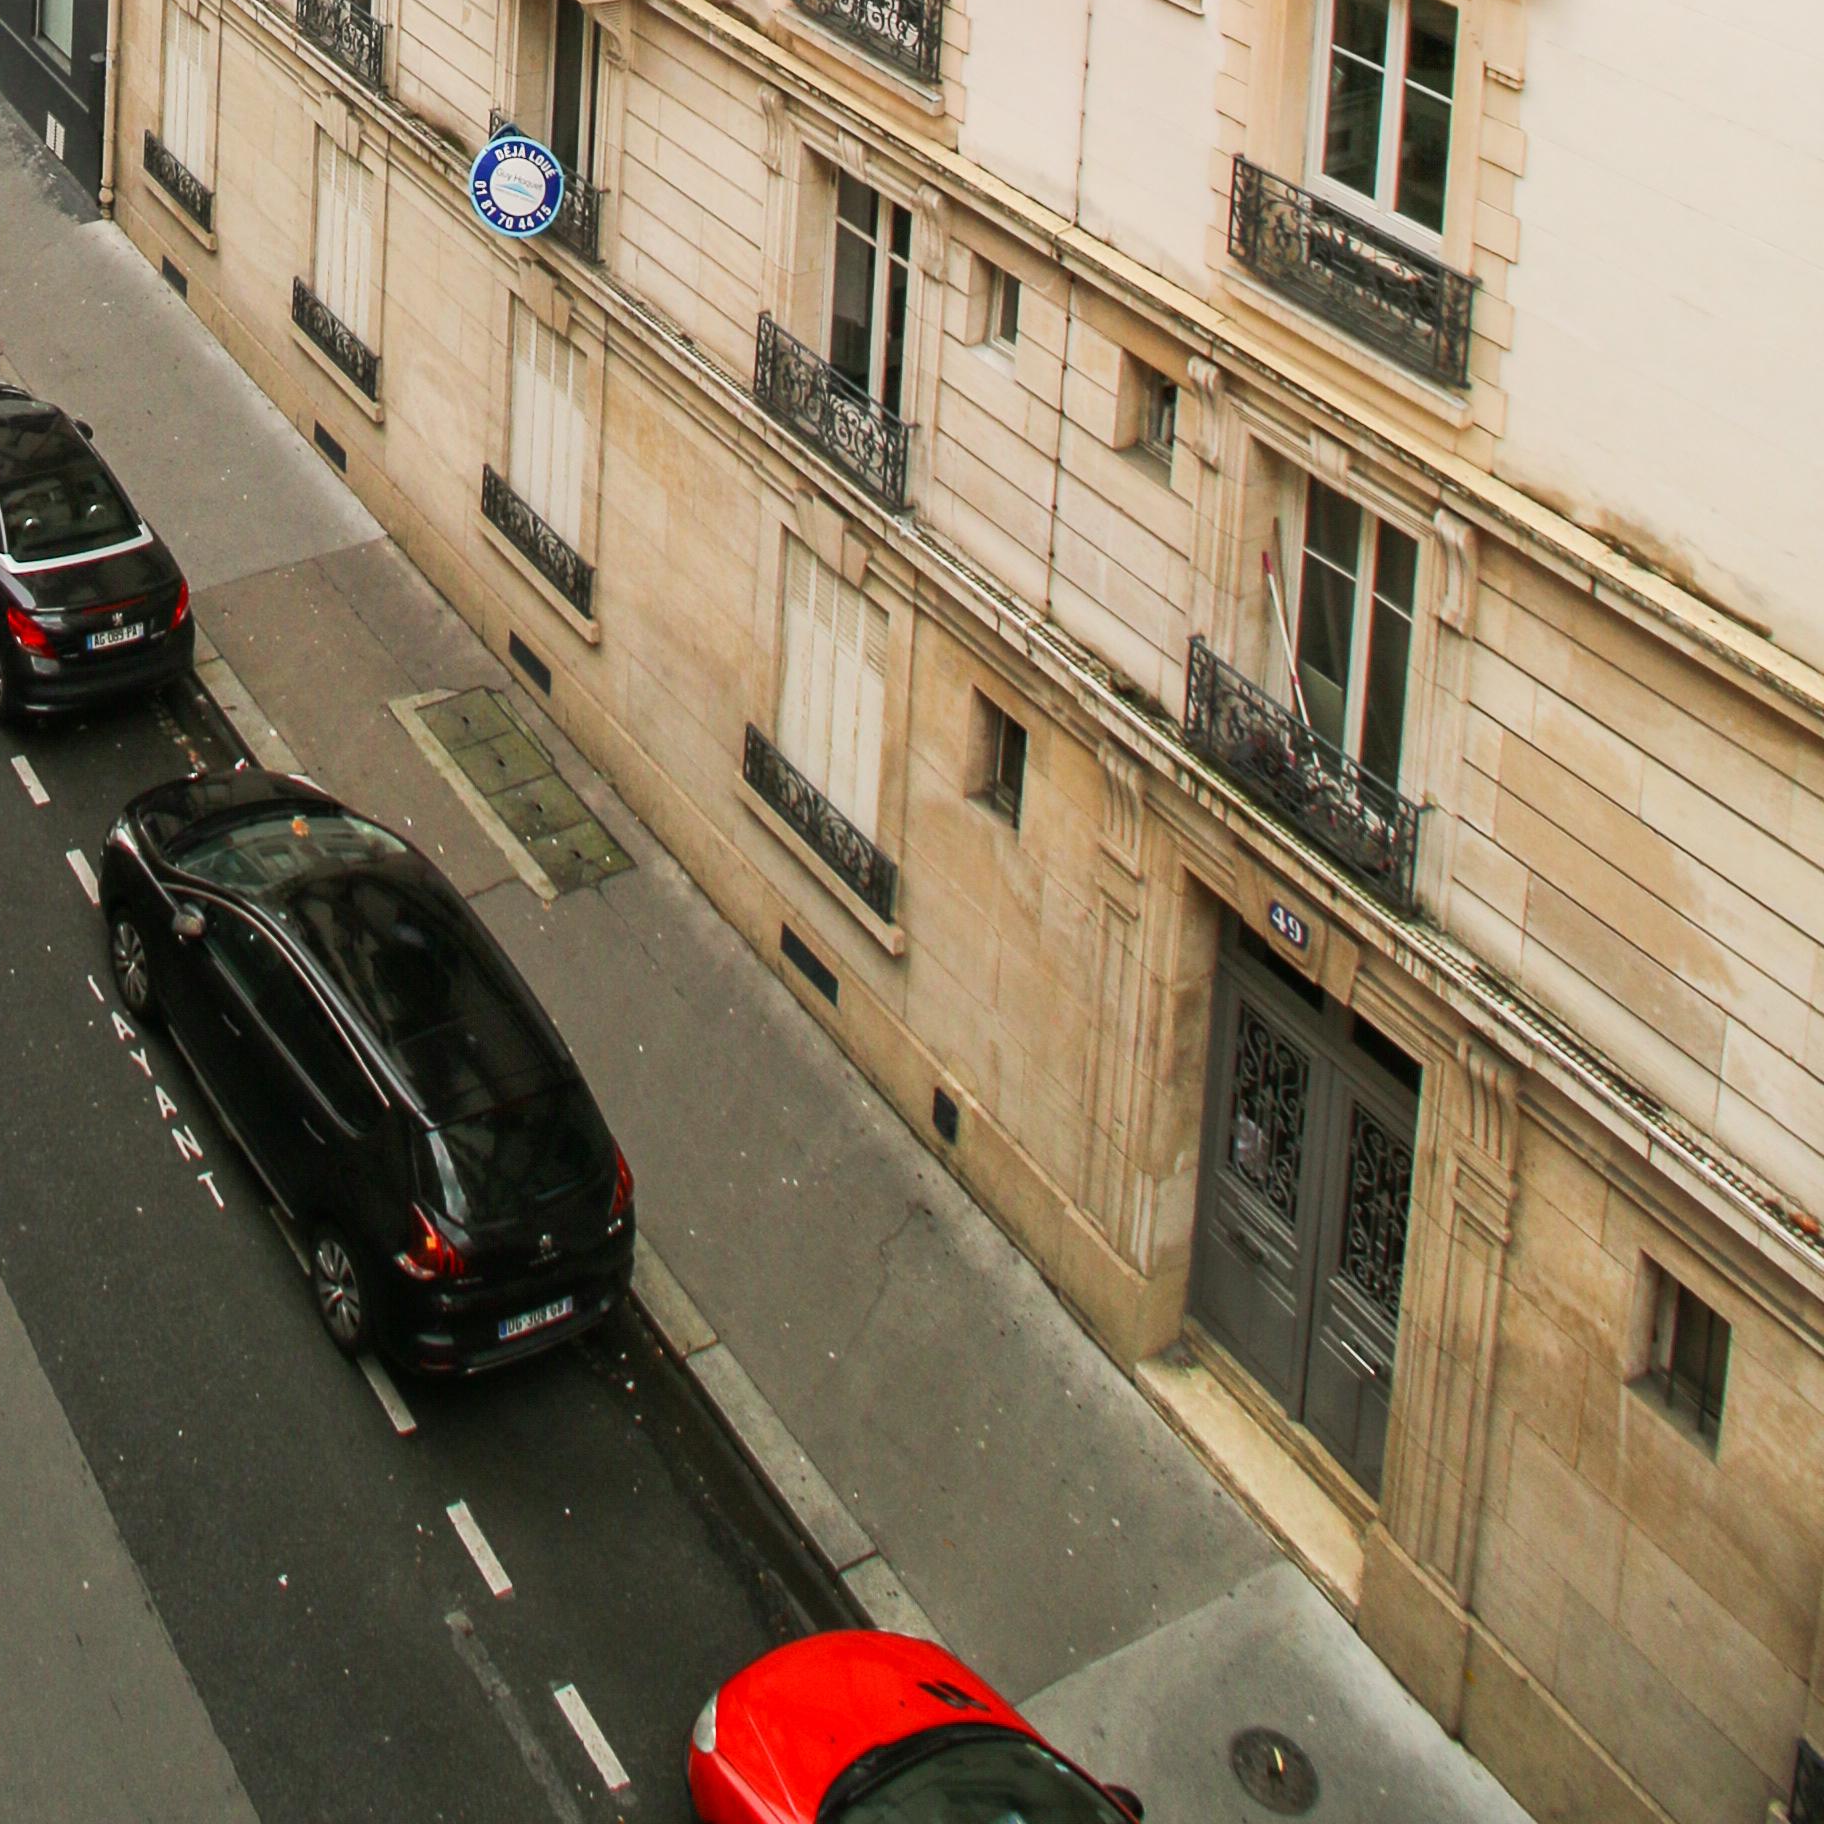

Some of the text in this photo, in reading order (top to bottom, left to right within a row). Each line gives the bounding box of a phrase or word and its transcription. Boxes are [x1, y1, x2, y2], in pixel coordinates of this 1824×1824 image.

[495, 143, 558, 179] DÉJÀ LOUÉ
[474, 180, 488, 195] 01
[480, 199, 497, 216] 81
[536, 204, 552, 221] 15
[497, 213, 514, 229] 70
[518, 215, 535, 230] 44
[1271, 906, 1303, 944] 49
